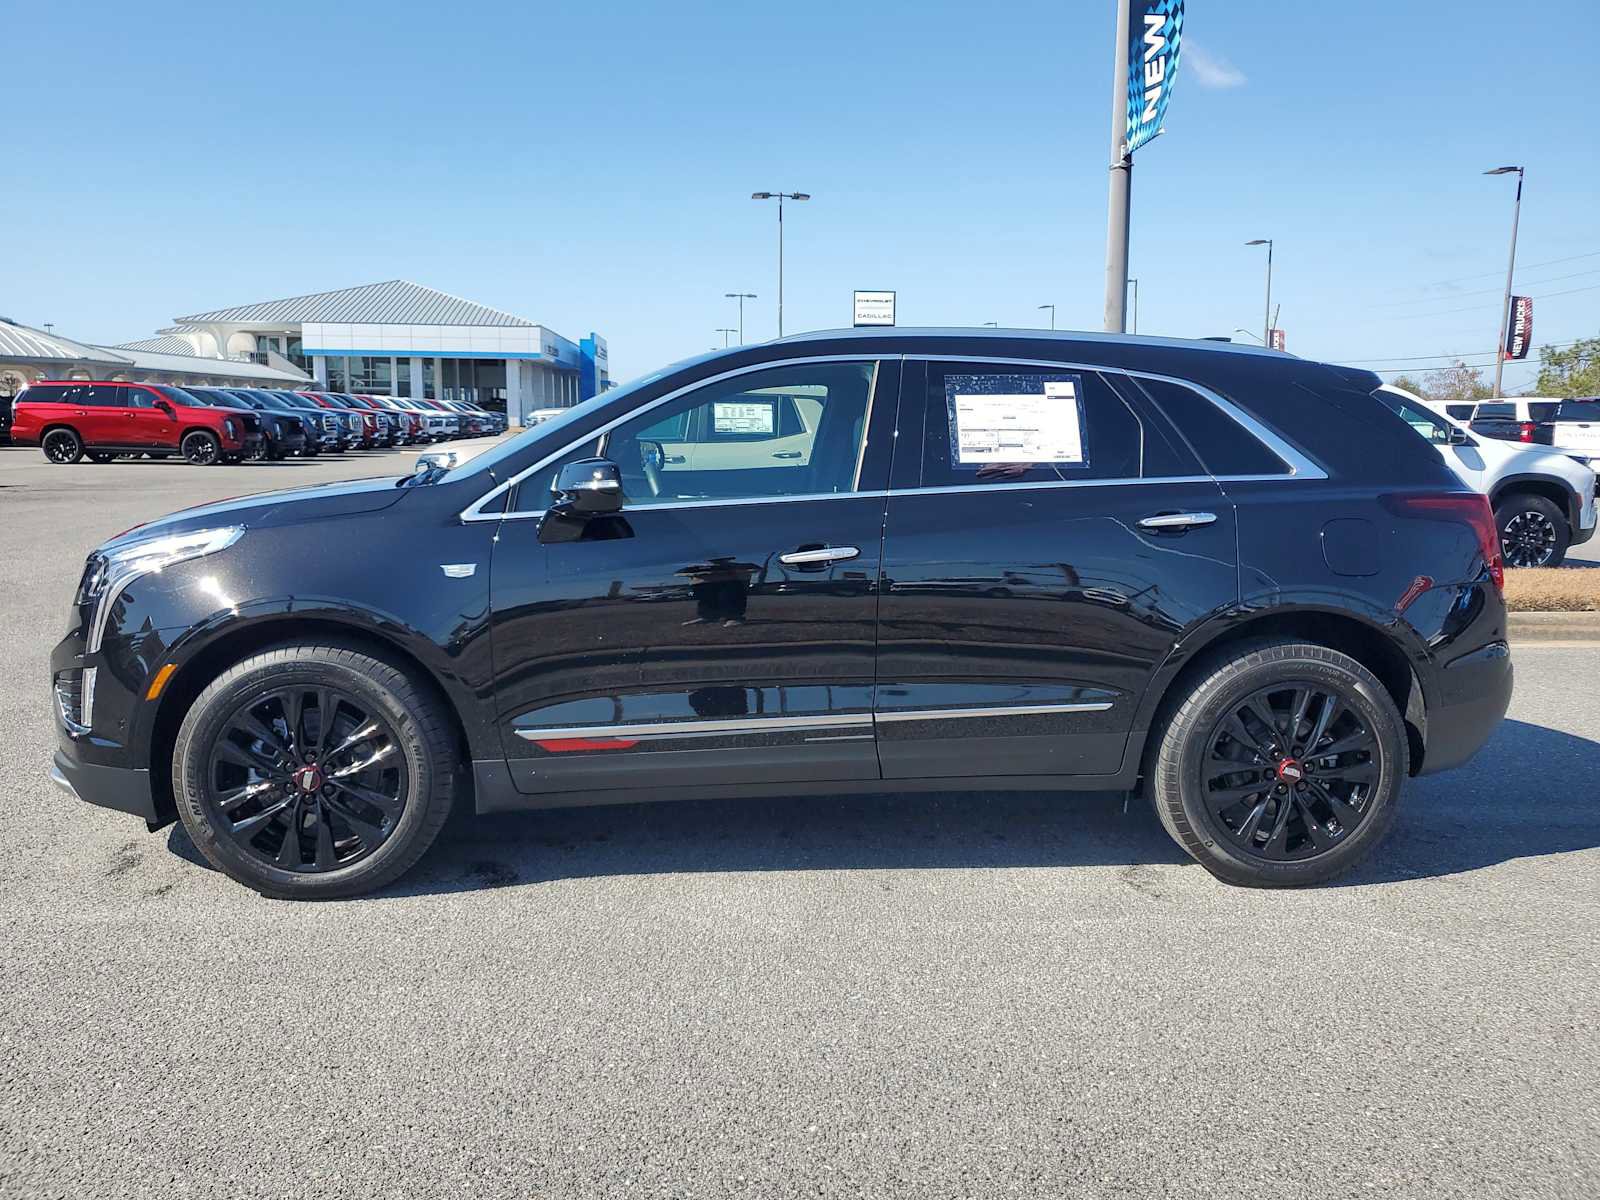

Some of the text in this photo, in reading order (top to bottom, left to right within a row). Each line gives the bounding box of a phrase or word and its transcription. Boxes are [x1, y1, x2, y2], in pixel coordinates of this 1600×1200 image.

[1142, 14, 1166, 124] NEW
[1512, 299, 1526, 356] NEW TRUCKS
